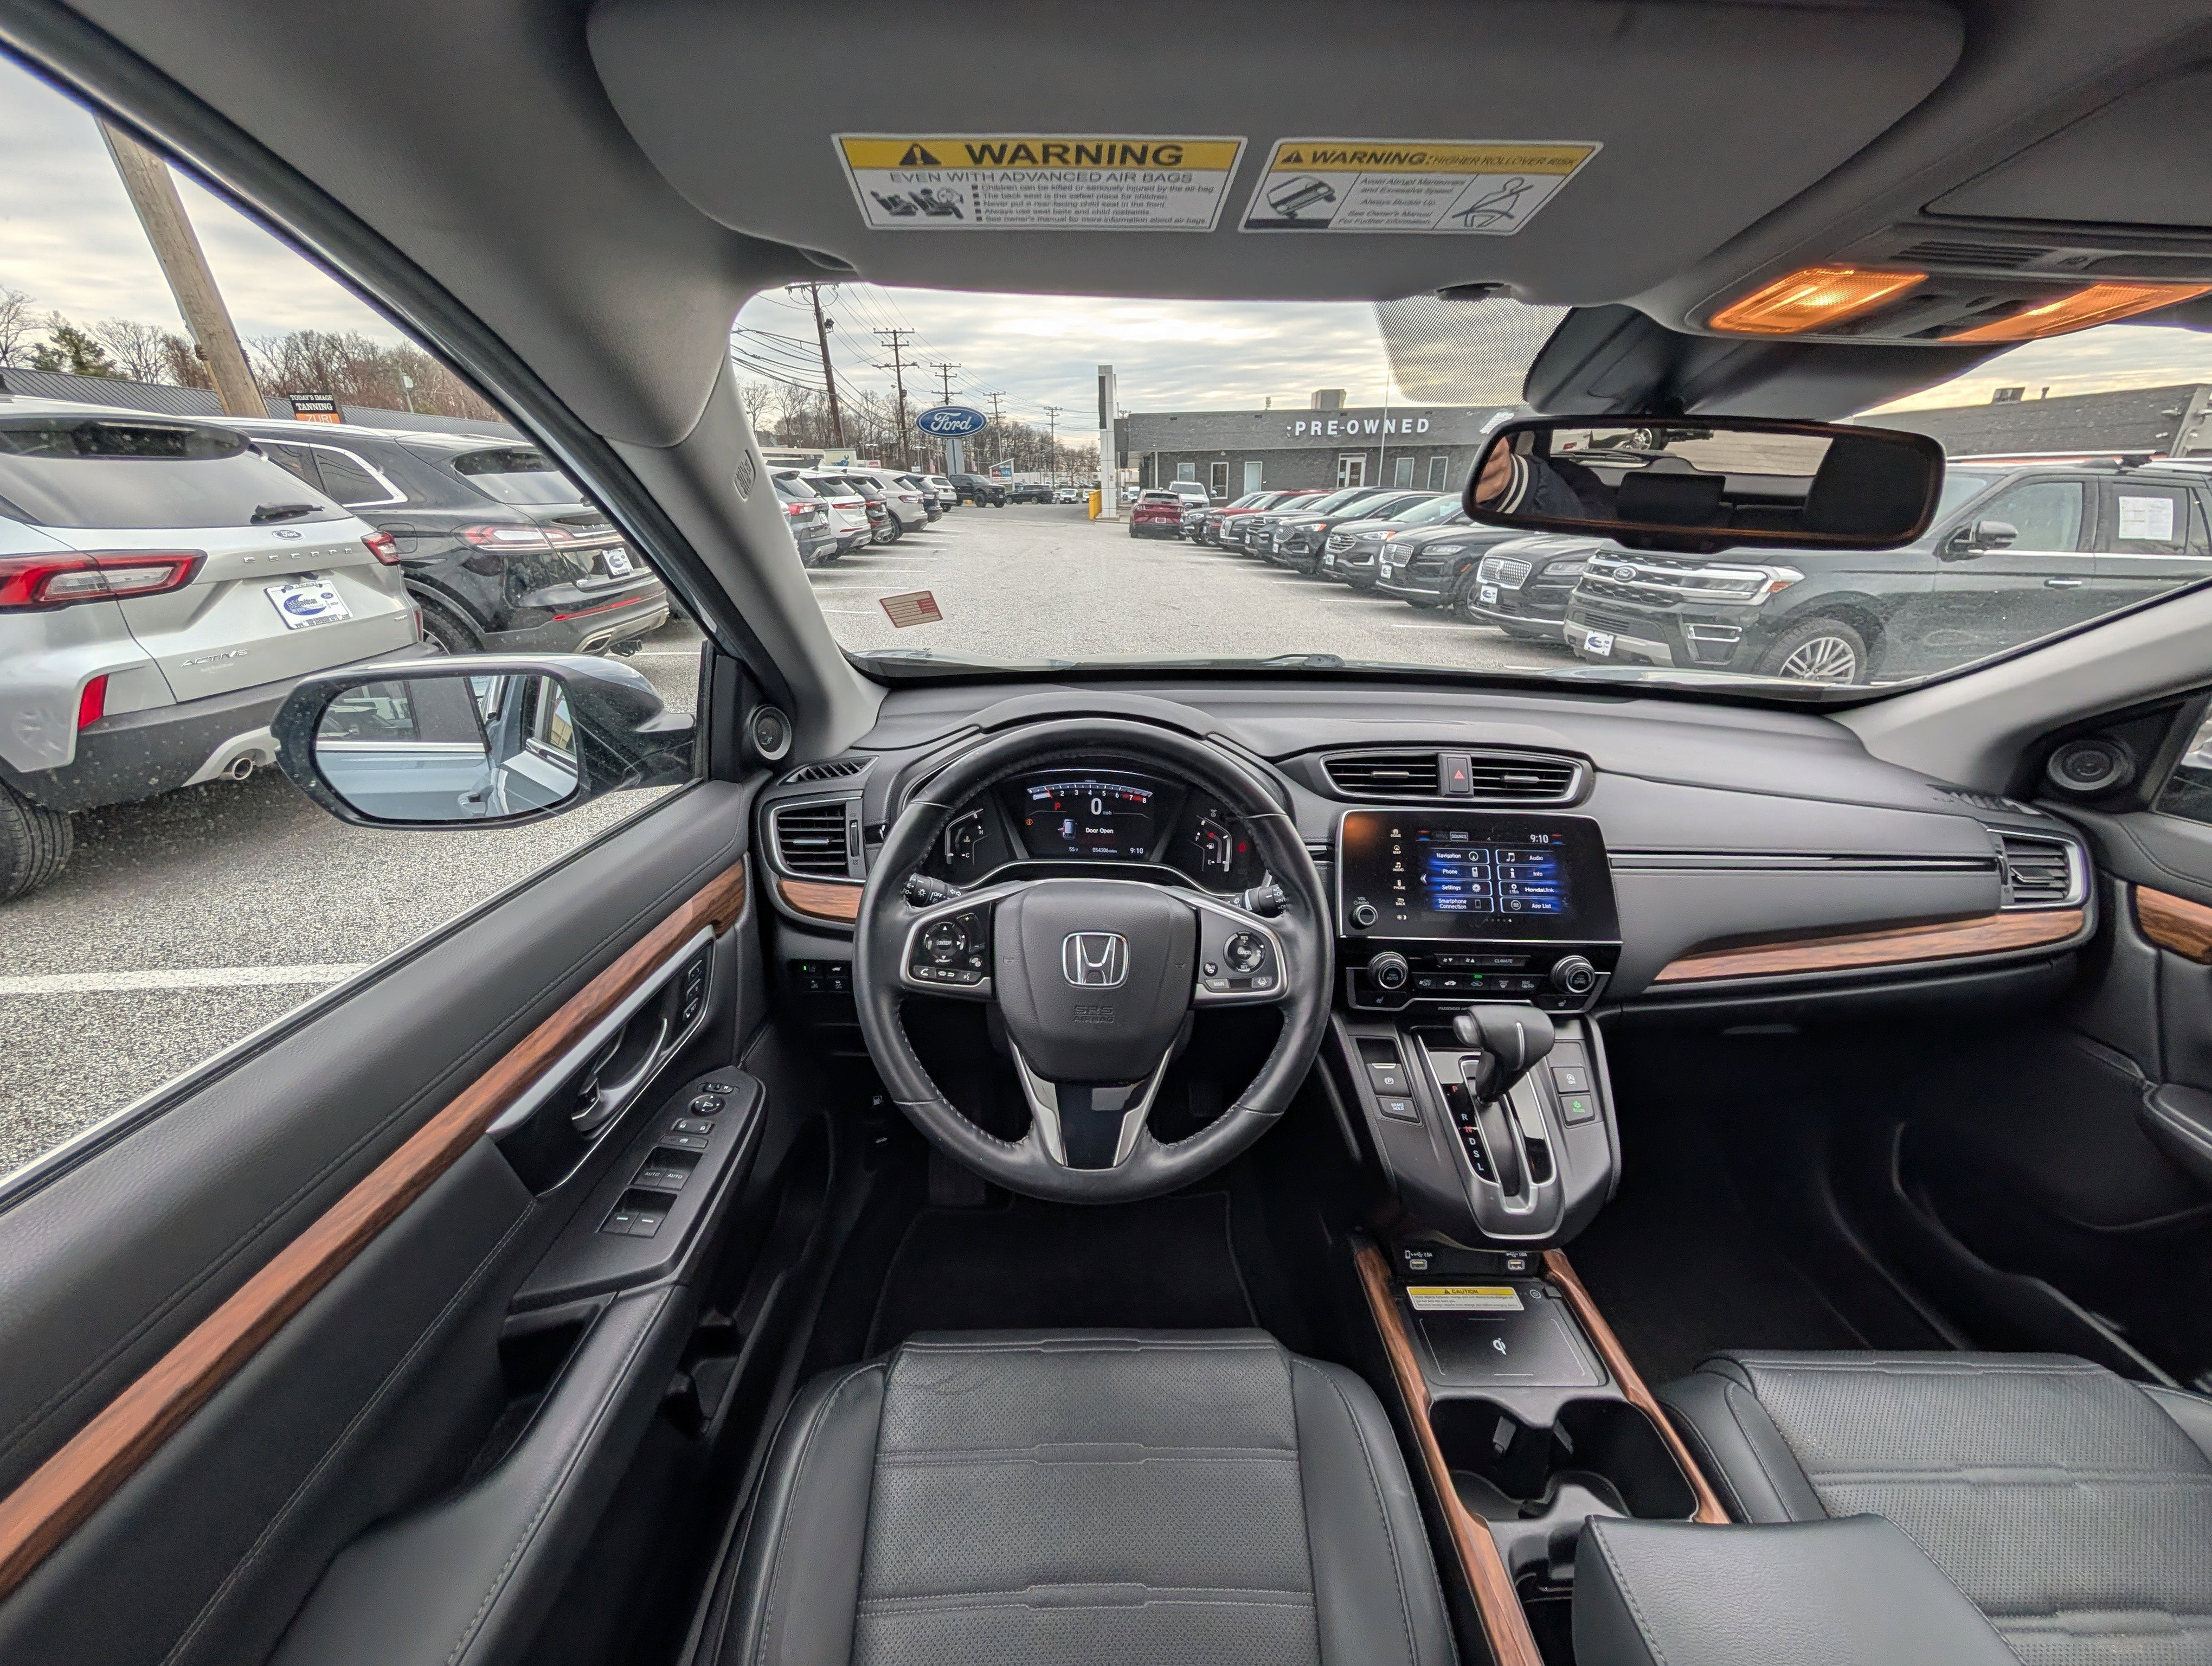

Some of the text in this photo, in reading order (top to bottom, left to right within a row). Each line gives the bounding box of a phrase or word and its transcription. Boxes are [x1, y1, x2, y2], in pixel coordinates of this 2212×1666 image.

[964, 143, 1184, 166] WARNING
[1482, 155, 1546, 165] ROLLOVER
[890, 171, 1193, 183] EVEN WITH ADVANCED AIR BAGS
[295, 402, 333, 411] TANNING
[930, 412, 972, 431] Ford
[1295, 418, 1430, 437] PRE-OWNED
[243, 548, 352, 563] ESCAPE
[180, 649, 248, 668] ACTIVE
[1053, 802, 1061, 810] P
[1091, 798, 1102, 815] 0
[1530, 834, 1549, 844] 9:10
[1073, 1005, 1114, 1015] SRS
[1073, 1015, 1115, 1024] AIRBAG
[1461, 1113, 1468, 1121] R
[1469, 1137, 1476, 1145] D
[1473, 1150, 1480, 1158] S
[1476, 1162, 1484, 1171] L
